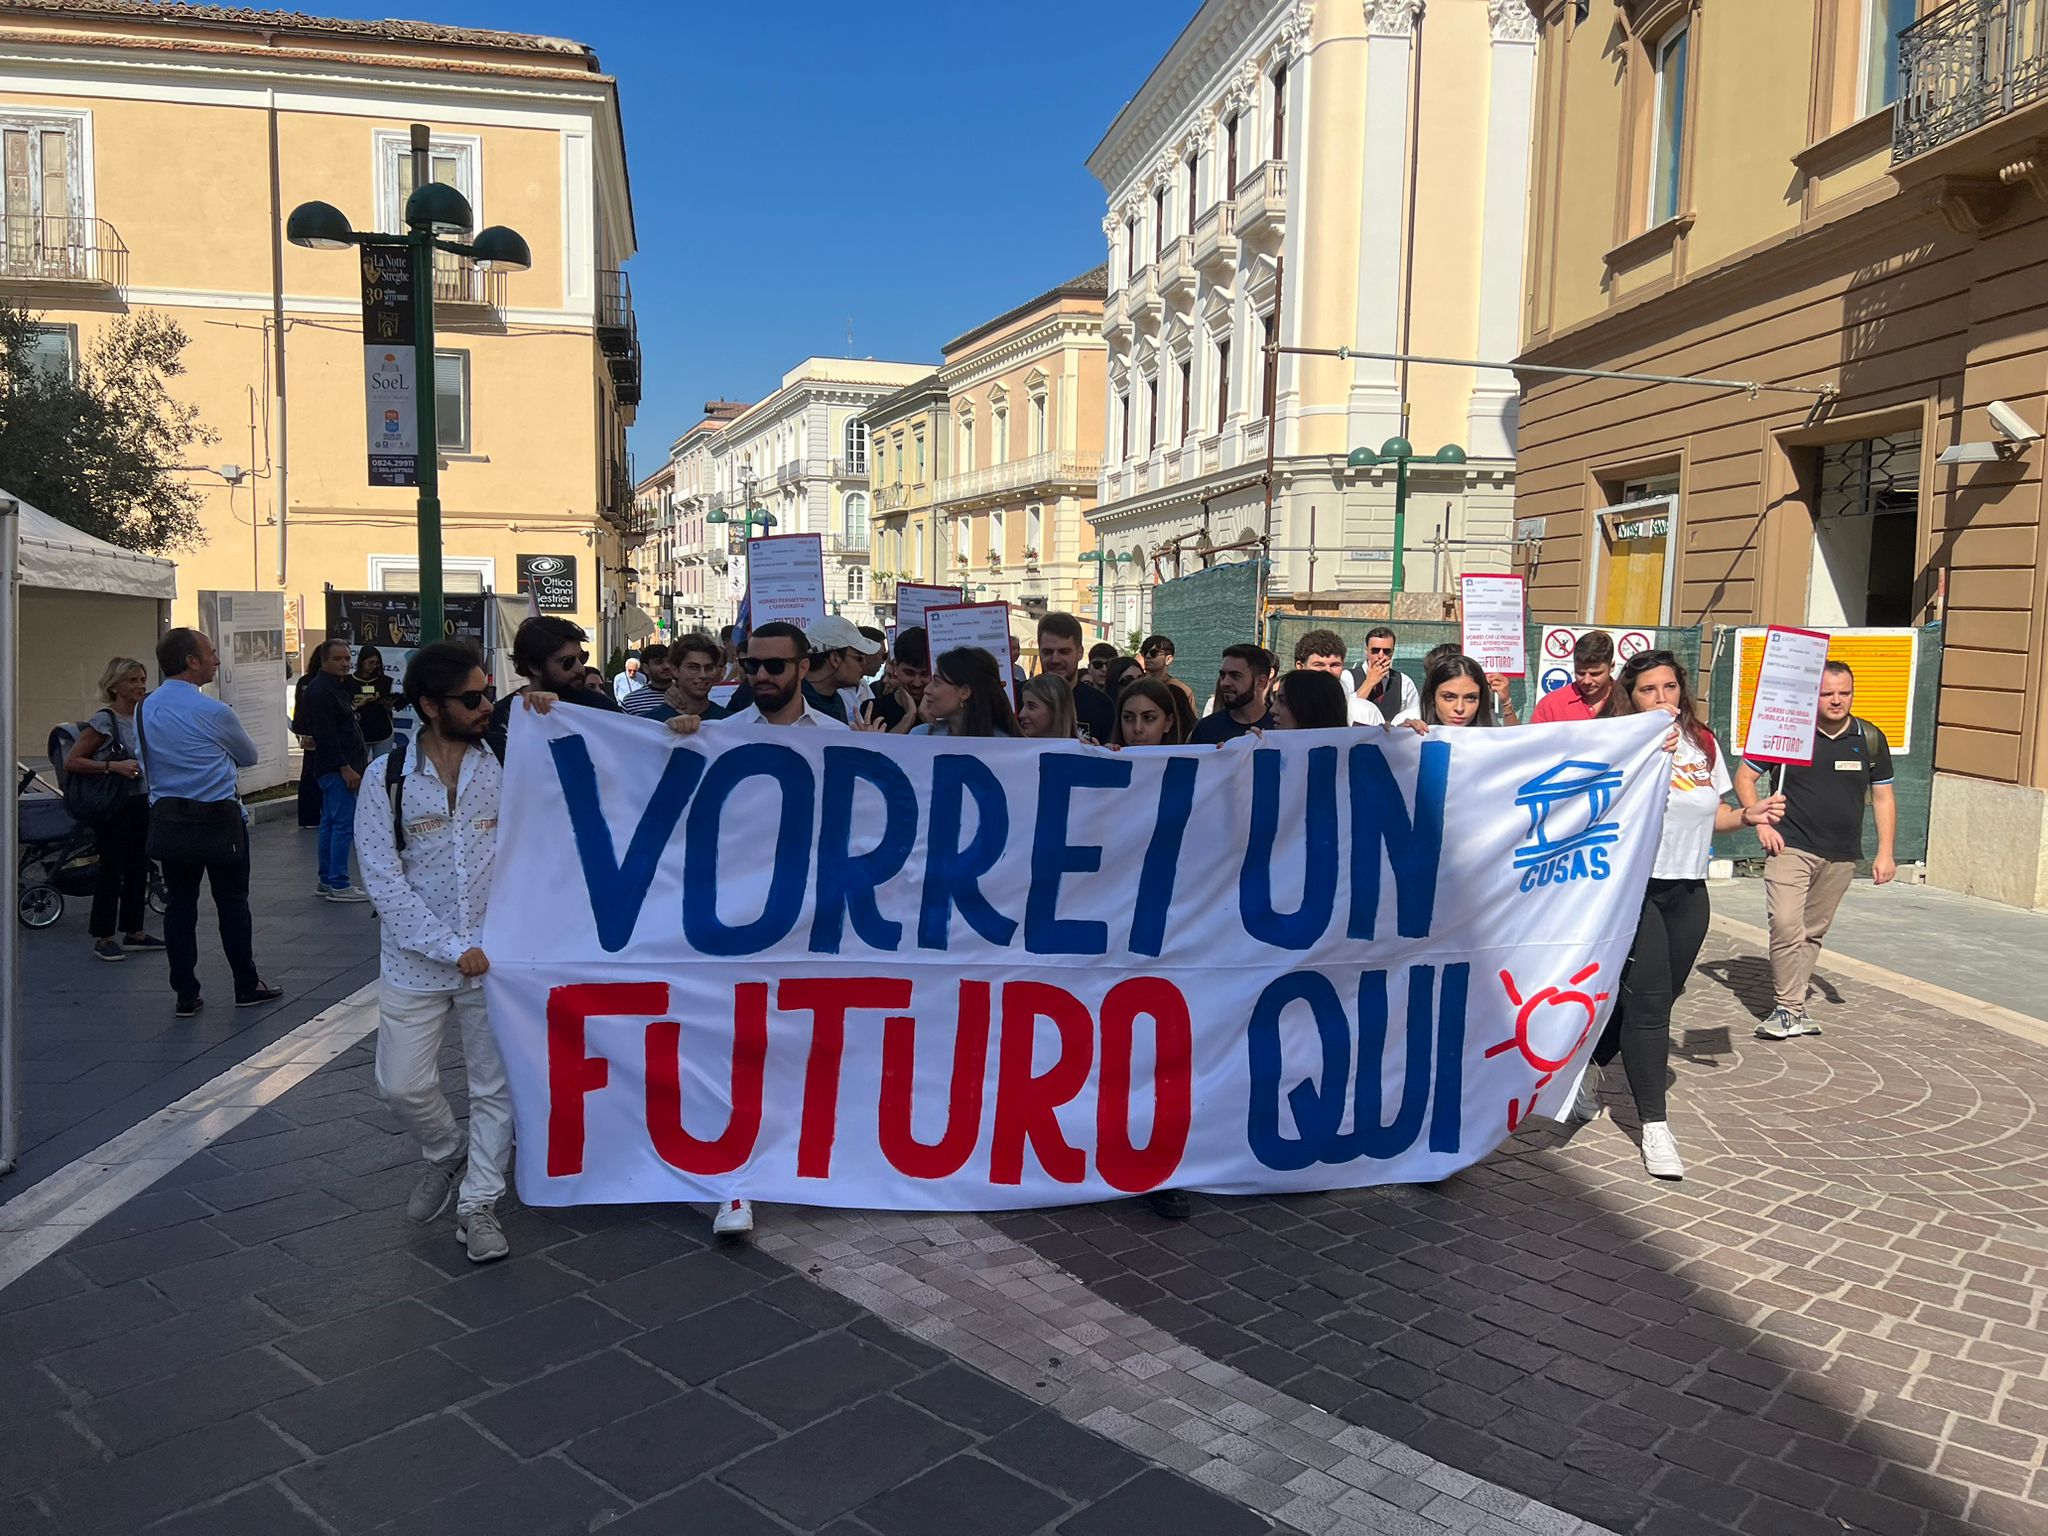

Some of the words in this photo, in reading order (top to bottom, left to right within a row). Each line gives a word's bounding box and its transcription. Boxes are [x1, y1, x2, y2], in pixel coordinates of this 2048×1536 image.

[374, 254, 384, 267] La
[385, 254, 407, 267] Notte
[381, 269, 409, 286] Streghe
[366, 288, 383, 306] 30
[541, 576, 573, 587] Ottica
[544, 586, 573, 595] Gianni
[1485, 656, 1511, 667] FUTURO
[1764, 706, 1785, 715] VORREI
[1770, 735, 1800, 752] FUTURO
[548, 734, 1199, 958] VORREI
[1239, 741, 1450, 950] UN
[1518, 845, 1611, 893] CUSAS
[548, 978, 1191, 1192] FUTURO
[1247, 963, 1470, 1171] QUI
